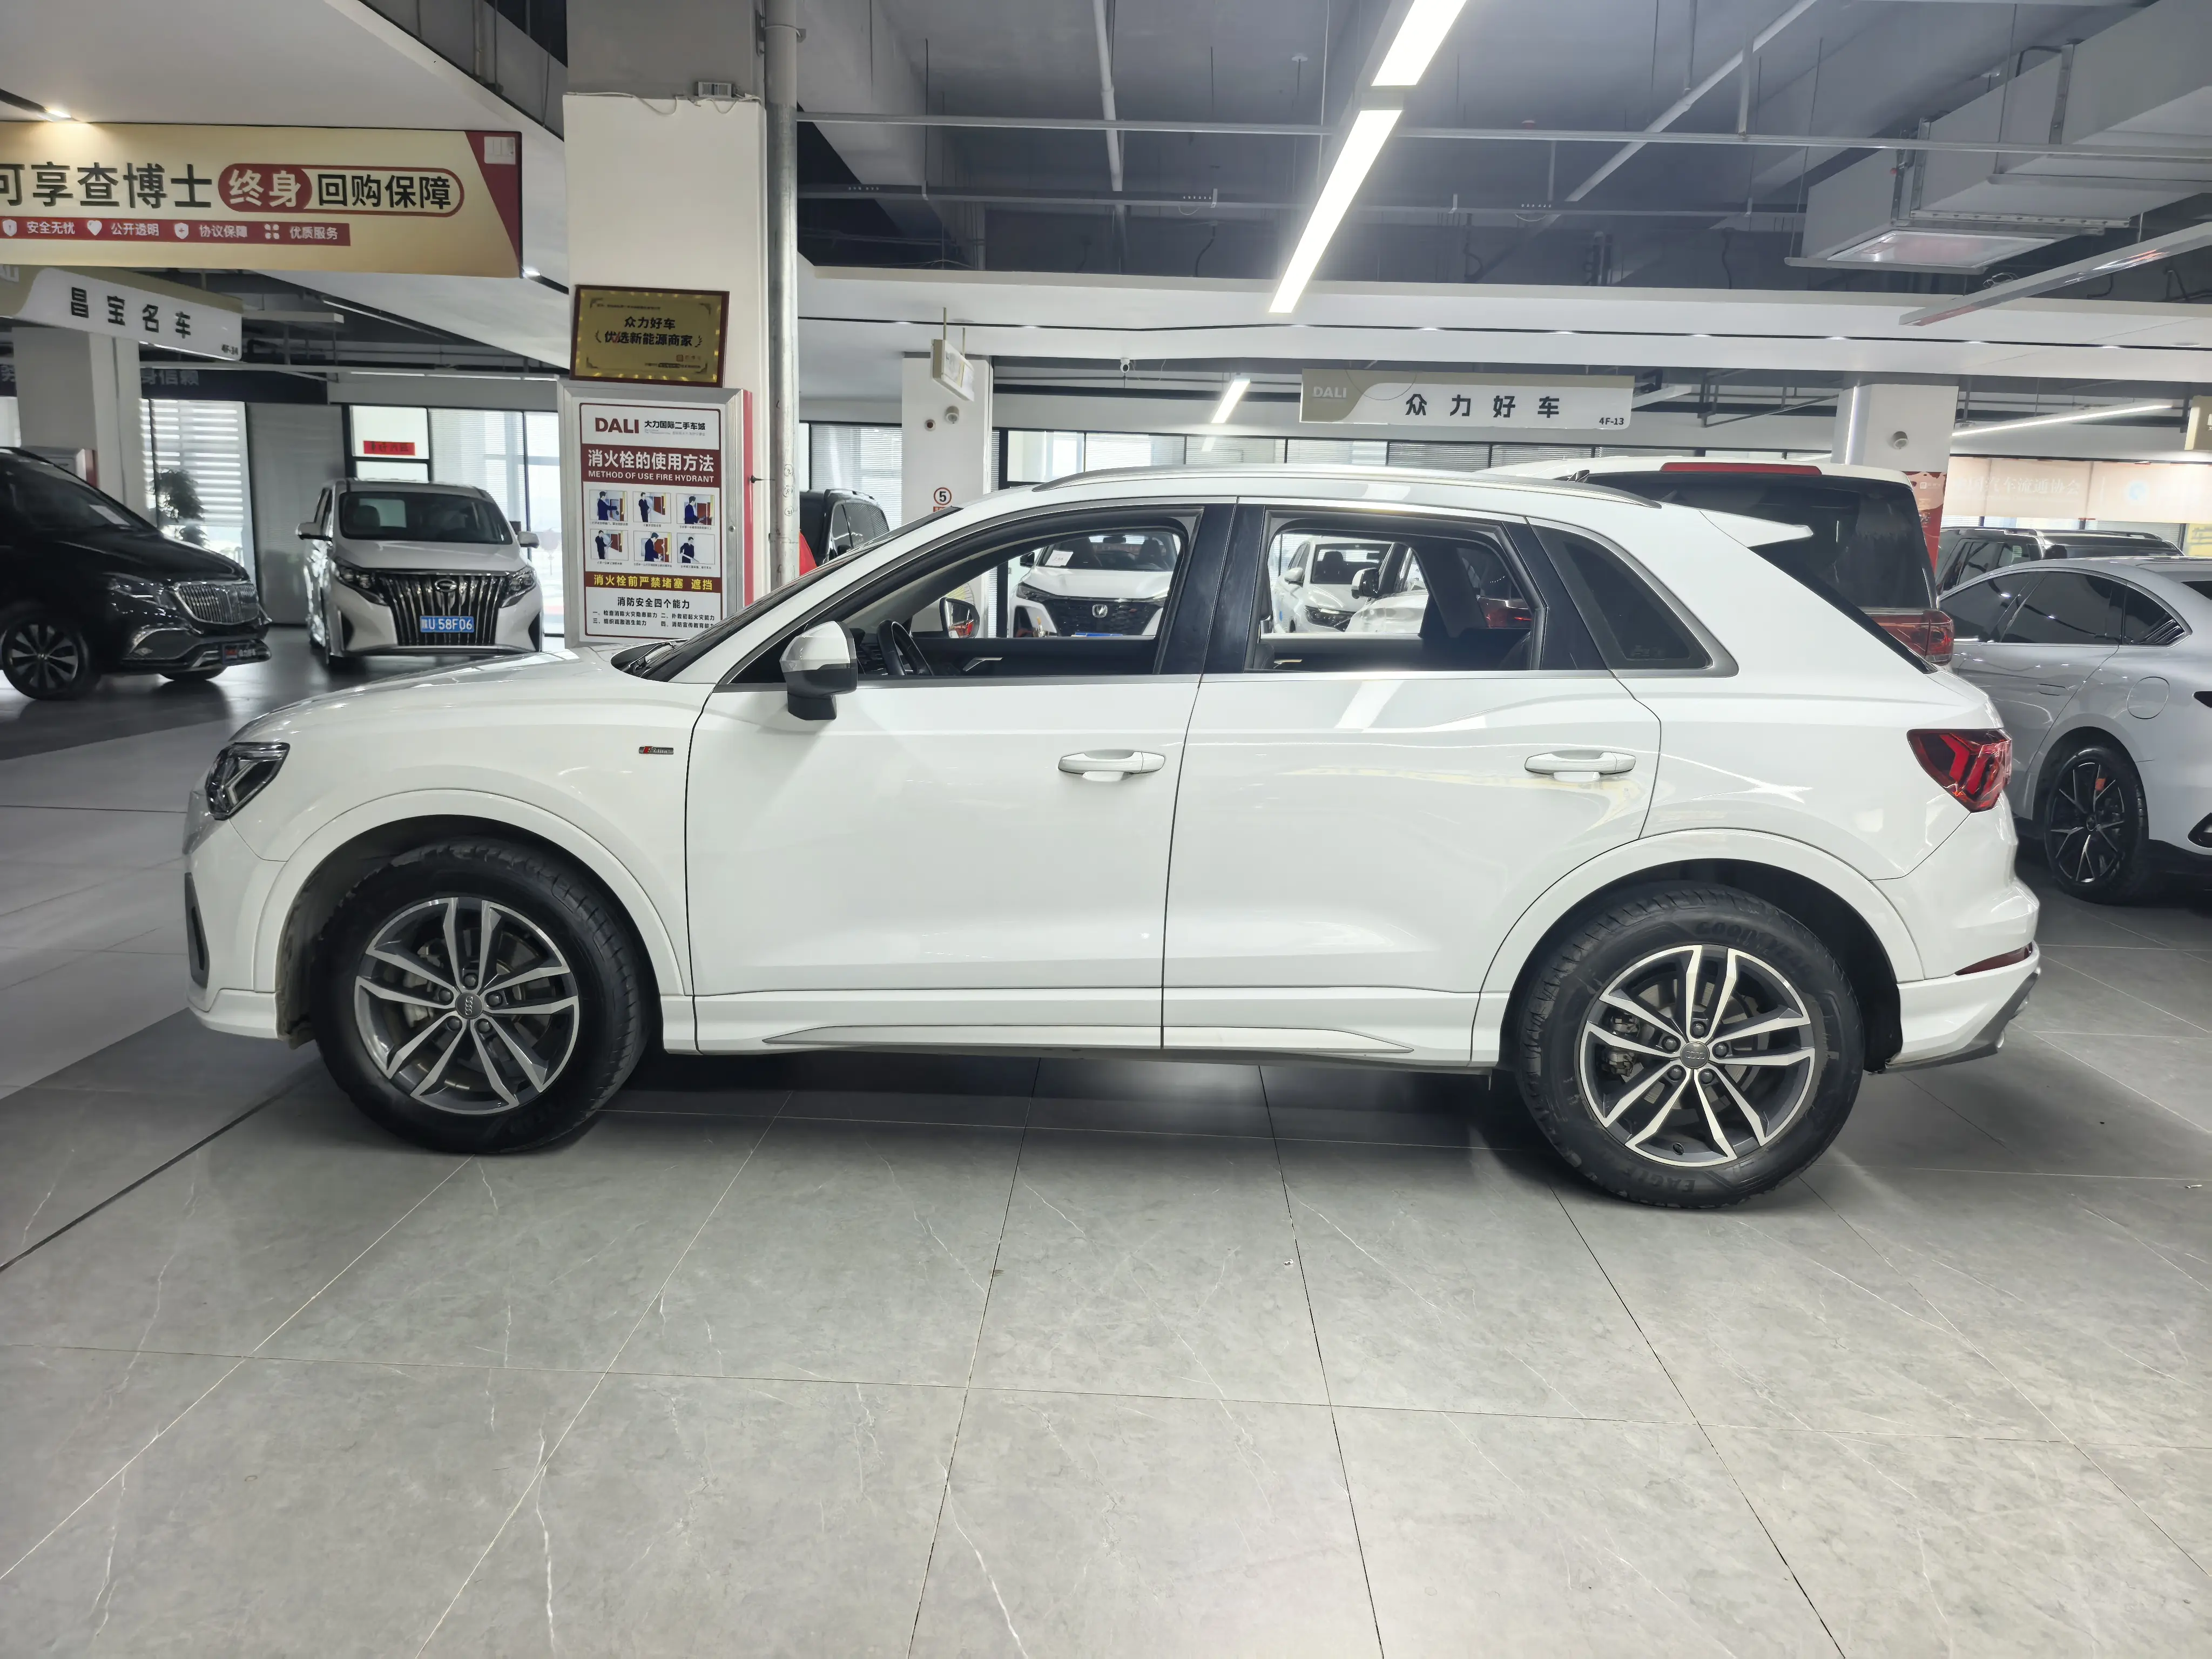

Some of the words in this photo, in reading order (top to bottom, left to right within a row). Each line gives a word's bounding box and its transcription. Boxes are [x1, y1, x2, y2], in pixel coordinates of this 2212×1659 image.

[26, 221, 76, 234] 安全无忧
[111, 222, 159, 237] 公开透明
[199, 224, 248, 238] 协议保障
[289, 226, 338, 240] 优质服务
[71, 287, 191, 339] 昌宝名车
[624, 316, 675, 329] 众力好车
[605, 331, 693, 347] 优选新能源商家
[1312, 386, 1347, 399] DALI
[1405, 393, 1560, 419] 众力好车
[595, 417, 639, 434] DALI
[644, 420, 705, 430] 大力国际二手车城
[1599, 416, 1624, 426] 4F-13
[588, 449, 714, 473] 消火栓的使用方法
[588, 470, 623, 478] METHOD
[675, 475, 714, 483] HYDRANT
[939, 491, 947, 502] 5
[594, 575, 683, 589] 消火栓前严禁堵塞
[691, 579, 713, 590] 遮挡
[617, 597, 690, 609] 消防安全四个能力
